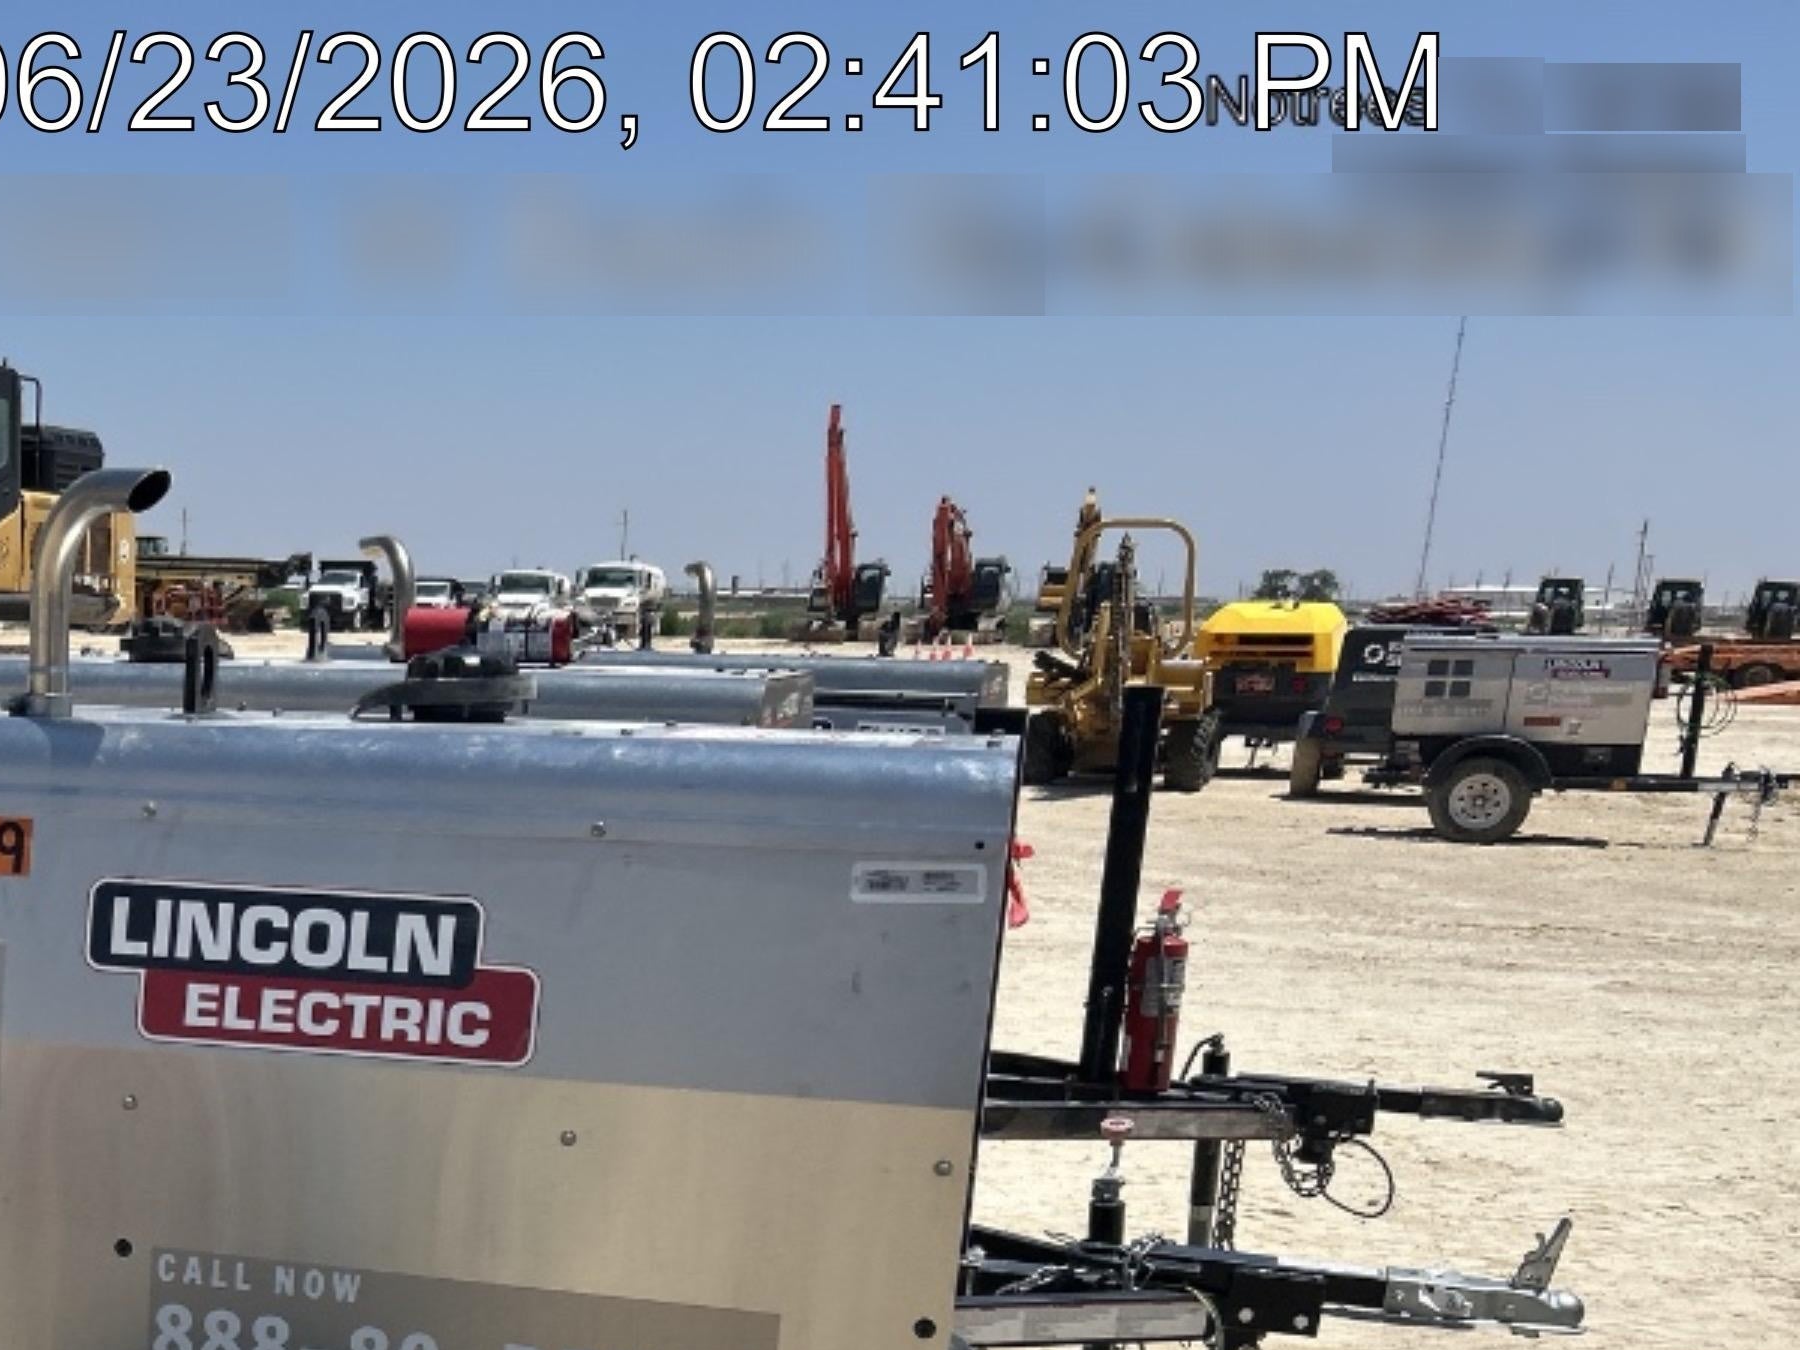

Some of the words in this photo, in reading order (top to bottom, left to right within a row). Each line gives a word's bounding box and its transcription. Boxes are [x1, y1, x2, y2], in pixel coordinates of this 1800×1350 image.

[109, 896, 457, 977] LINCOLN
[182, 983, 492, 1049] ELECTRIC
[157, 1252, 253, 1292] CALL
[274, 1266, 363, 1304] NOW
